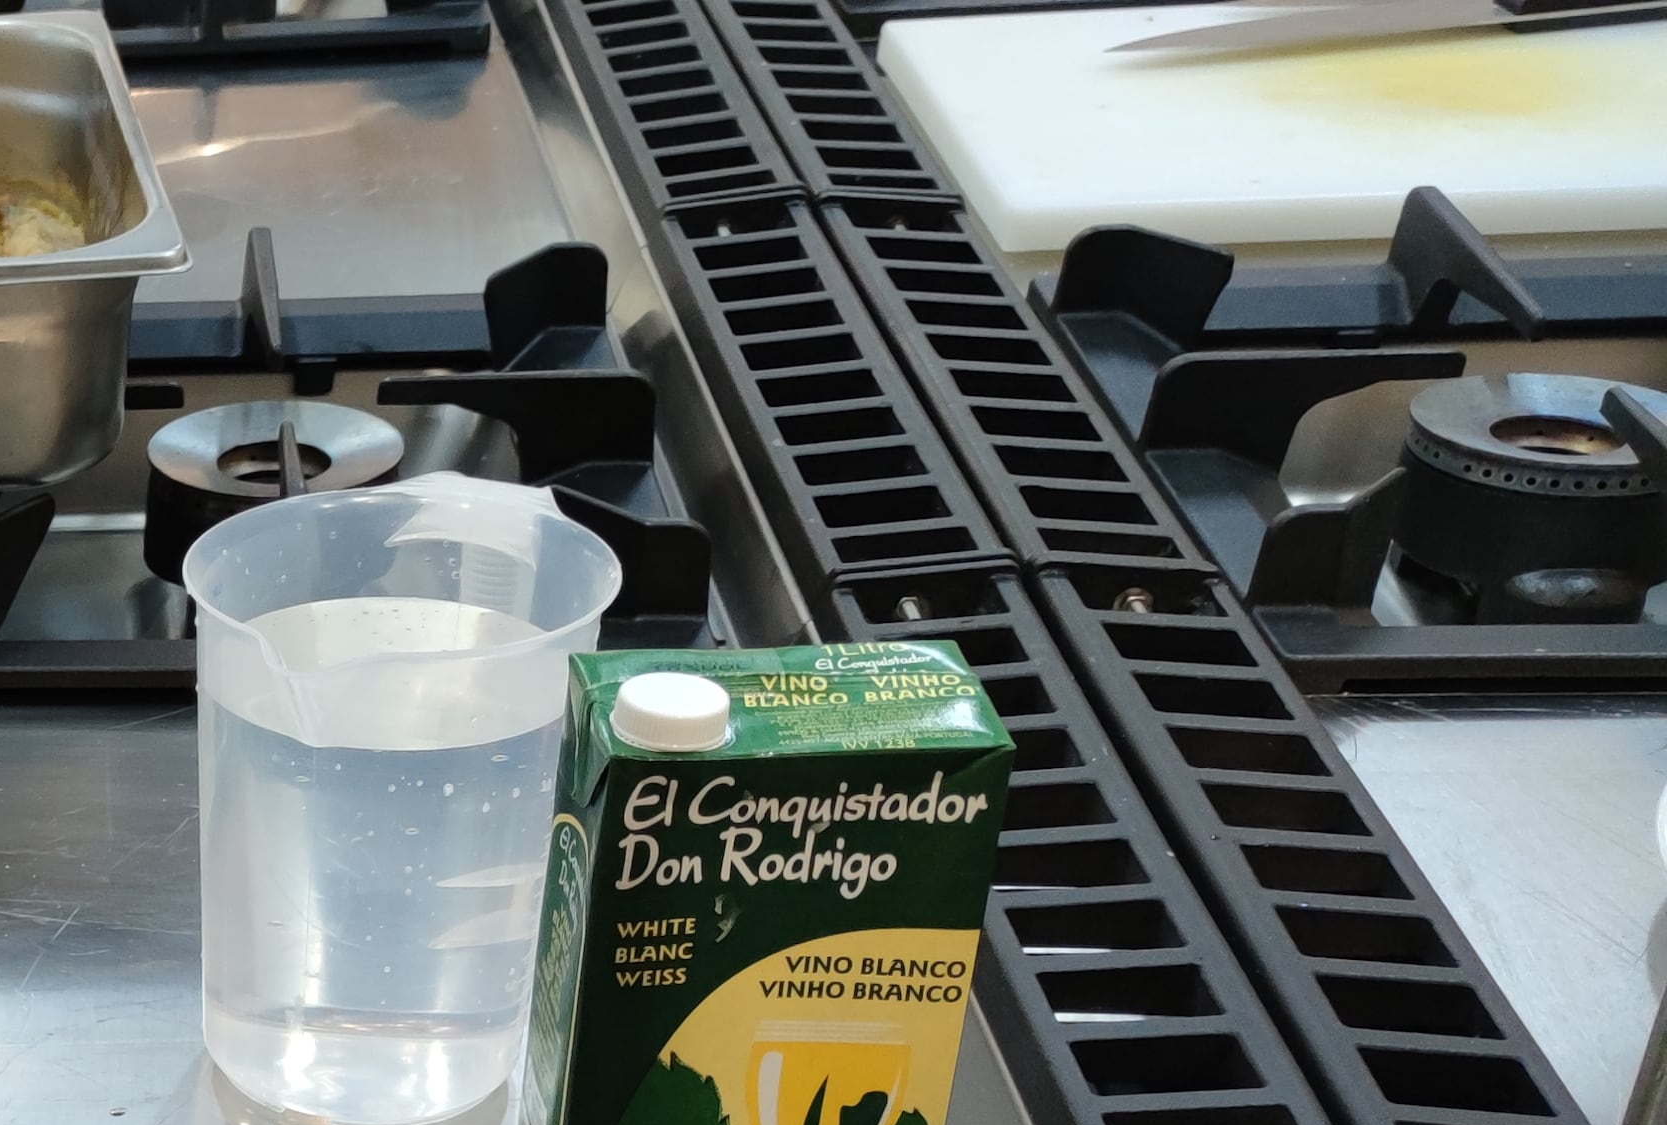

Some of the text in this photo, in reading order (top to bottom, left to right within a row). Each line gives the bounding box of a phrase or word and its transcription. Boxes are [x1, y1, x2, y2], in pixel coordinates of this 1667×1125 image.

[814, 658, 834, 671] El
[837, 652, 932, 675] Conquistador
[760, 674, 828, 692] VINO
[870, 673, 961, 689] VINHO
[744, 692, 848, 709] BLANCO
[864, 686, 975, 703] BRANCO
[622, 770, 989, 839] El Conquistador
[616, 832, 704, 891] Don
[719, 826, 898, 900] Rodrigo
[617, 917, 697, 940] WHITE
[614, 942, 694, 964] BLANC
[616, 966, 688, 988] WEISS
[785, 955, 967, 979] VINO BLANCO
[759, 979, 964, 1003] VINHO BRANCO
